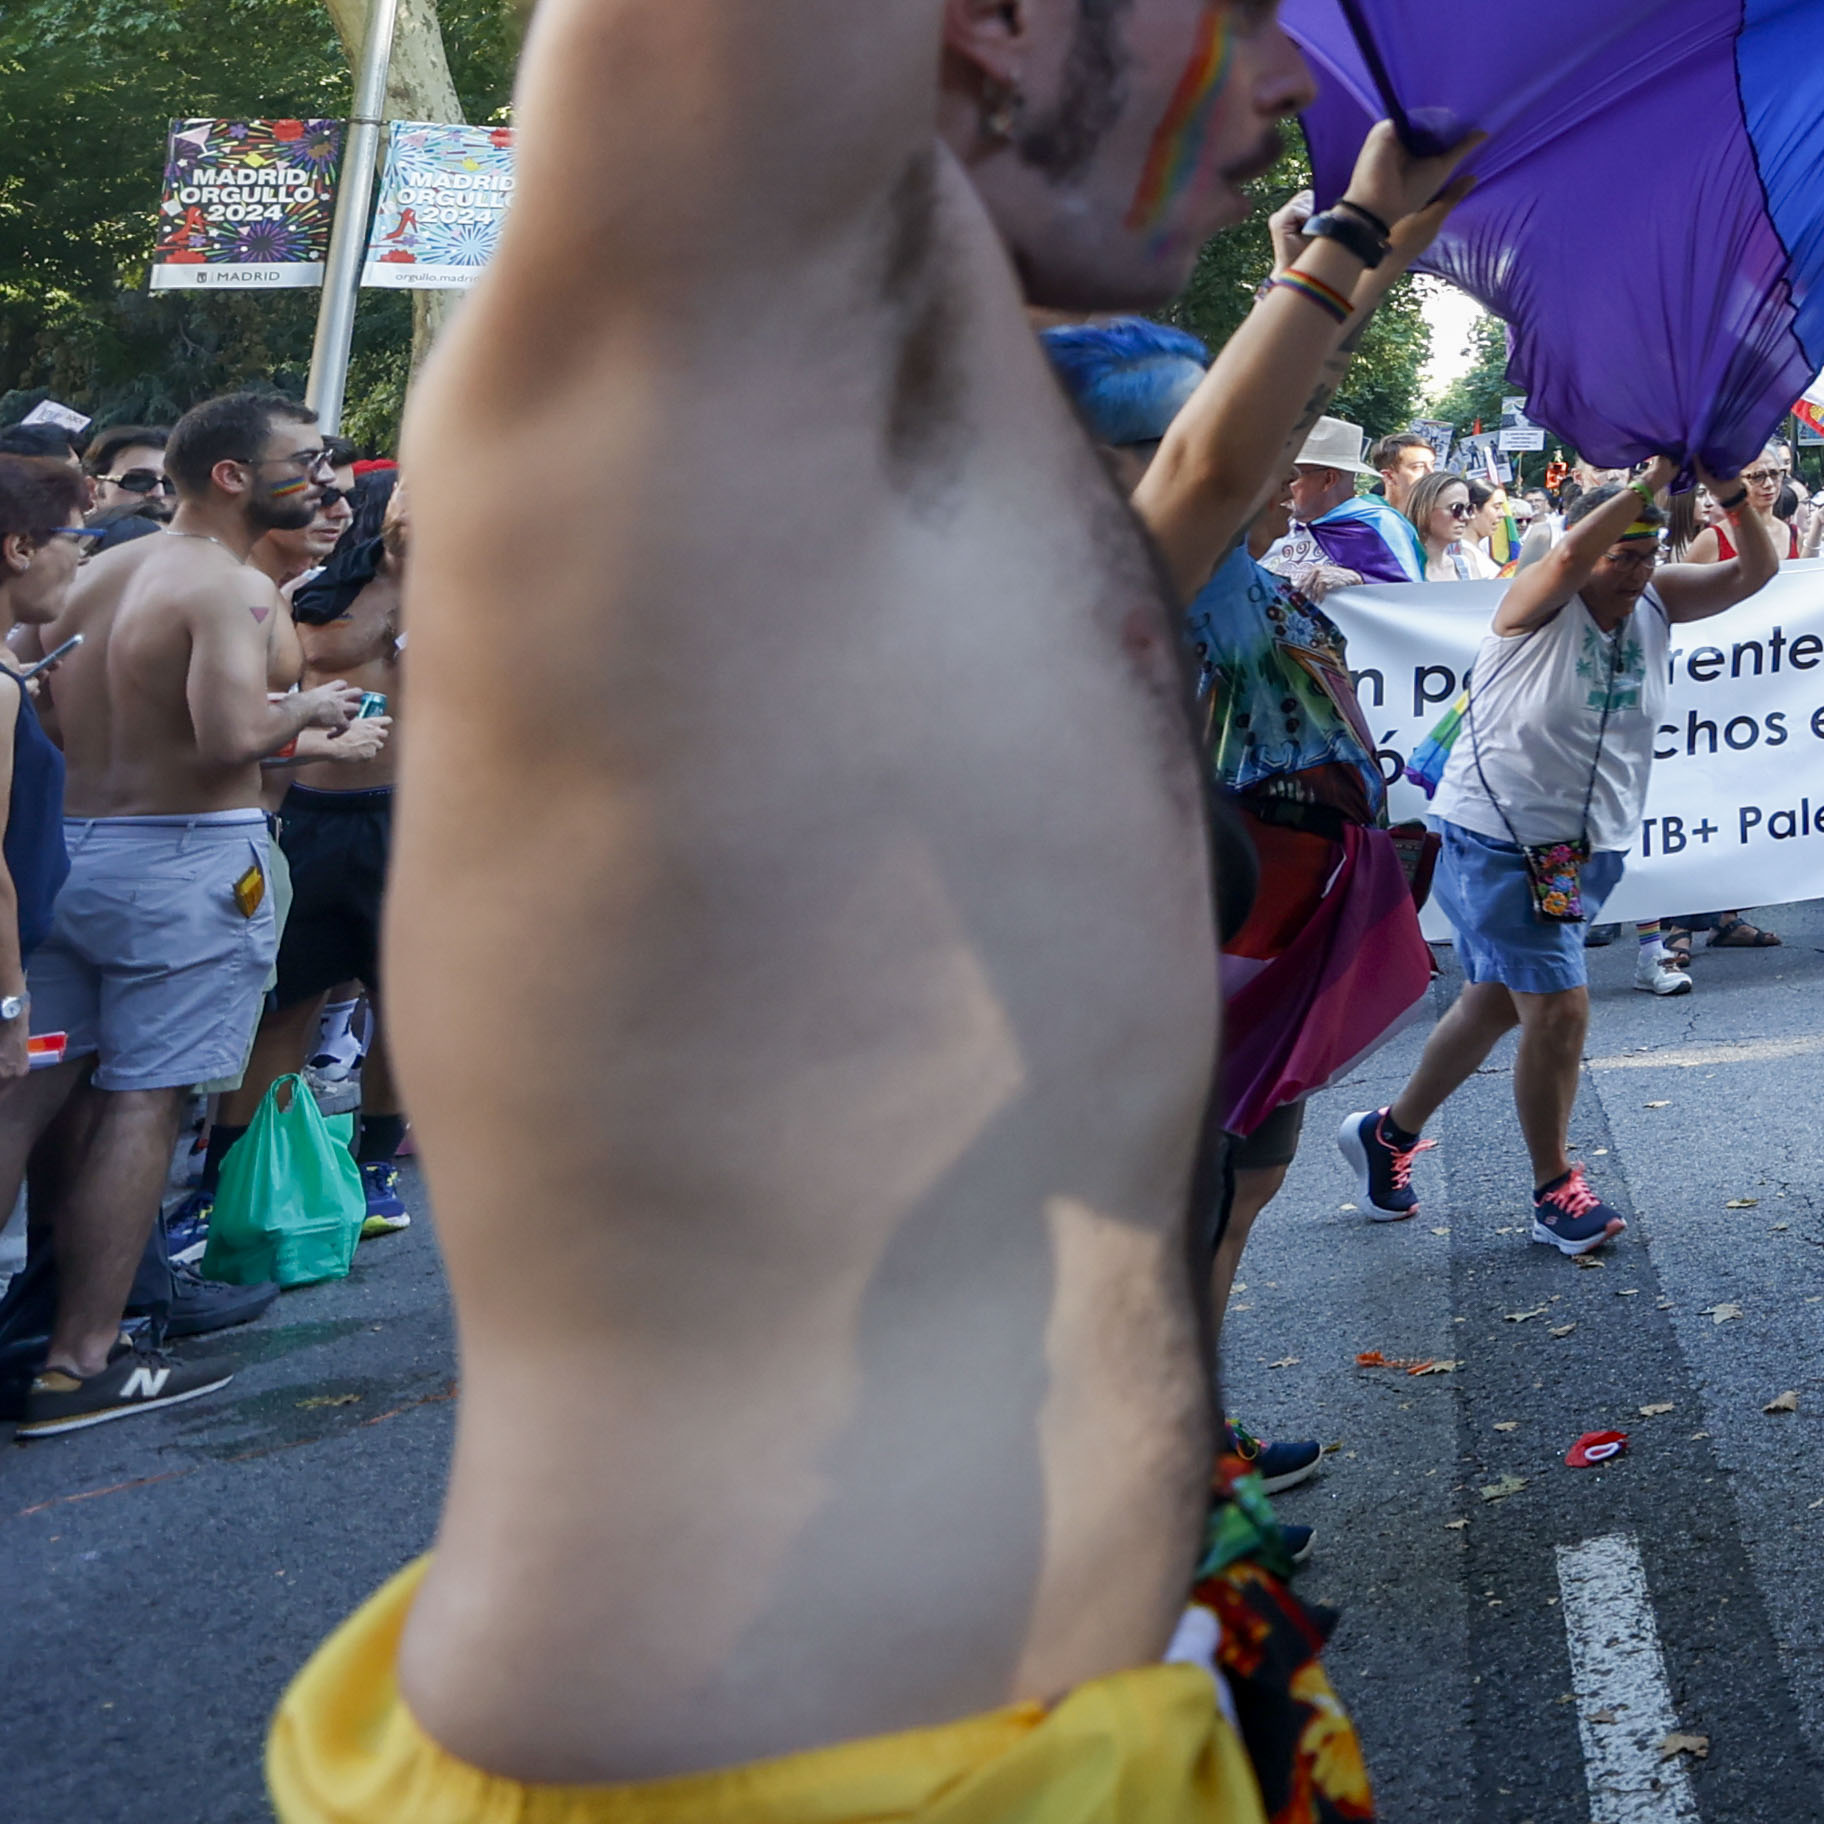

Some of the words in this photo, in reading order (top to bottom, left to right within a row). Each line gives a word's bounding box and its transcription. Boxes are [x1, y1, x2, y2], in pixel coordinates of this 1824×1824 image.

[192, 168, 308, 186] MADRID
[179, 186, 314, 204] ORGULLO
[207, 204, 284, 222] 2024
[416, 207, 493, 225] 2024
[216, 271, 280, 282] MADRID
[1642, 816, 1719, 858] TB+
